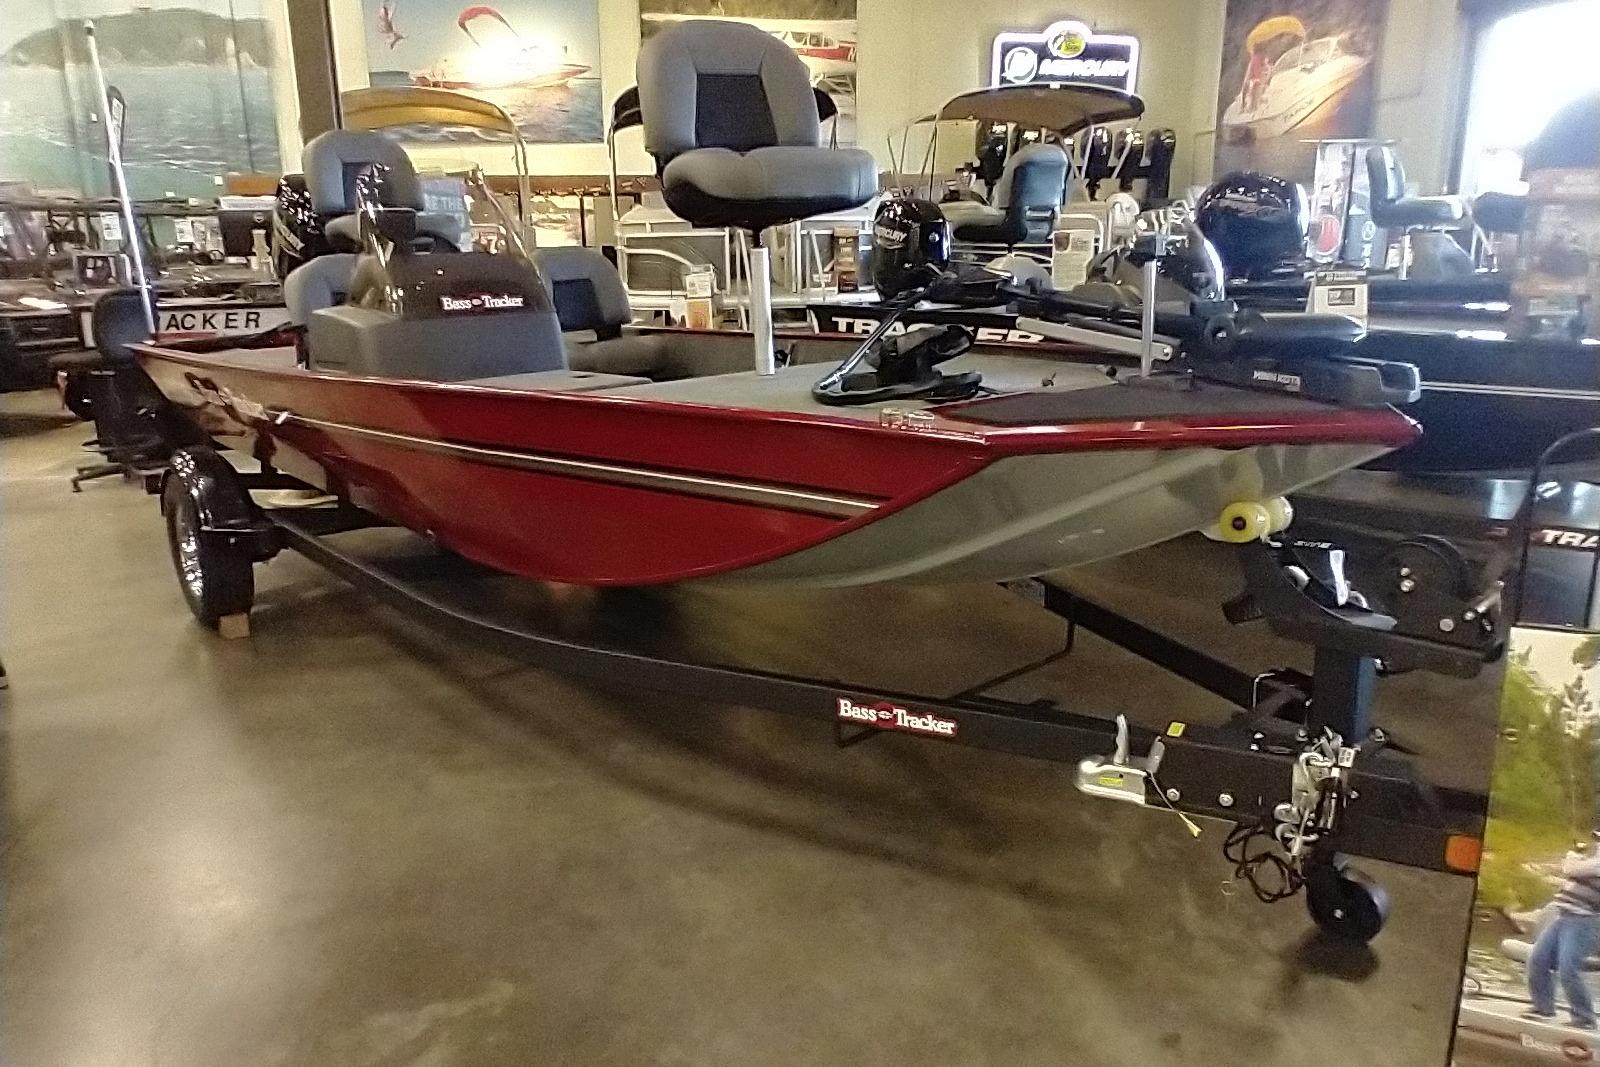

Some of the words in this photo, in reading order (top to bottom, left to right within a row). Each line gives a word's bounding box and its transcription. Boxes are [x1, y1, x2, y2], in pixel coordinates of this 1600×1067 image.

[440, 296, 472, 311] Bass
[480, 294, 524, 308] Tracker
[837, 697, 878, 722] Bass
[892, 706, 956, 735] Tracker
